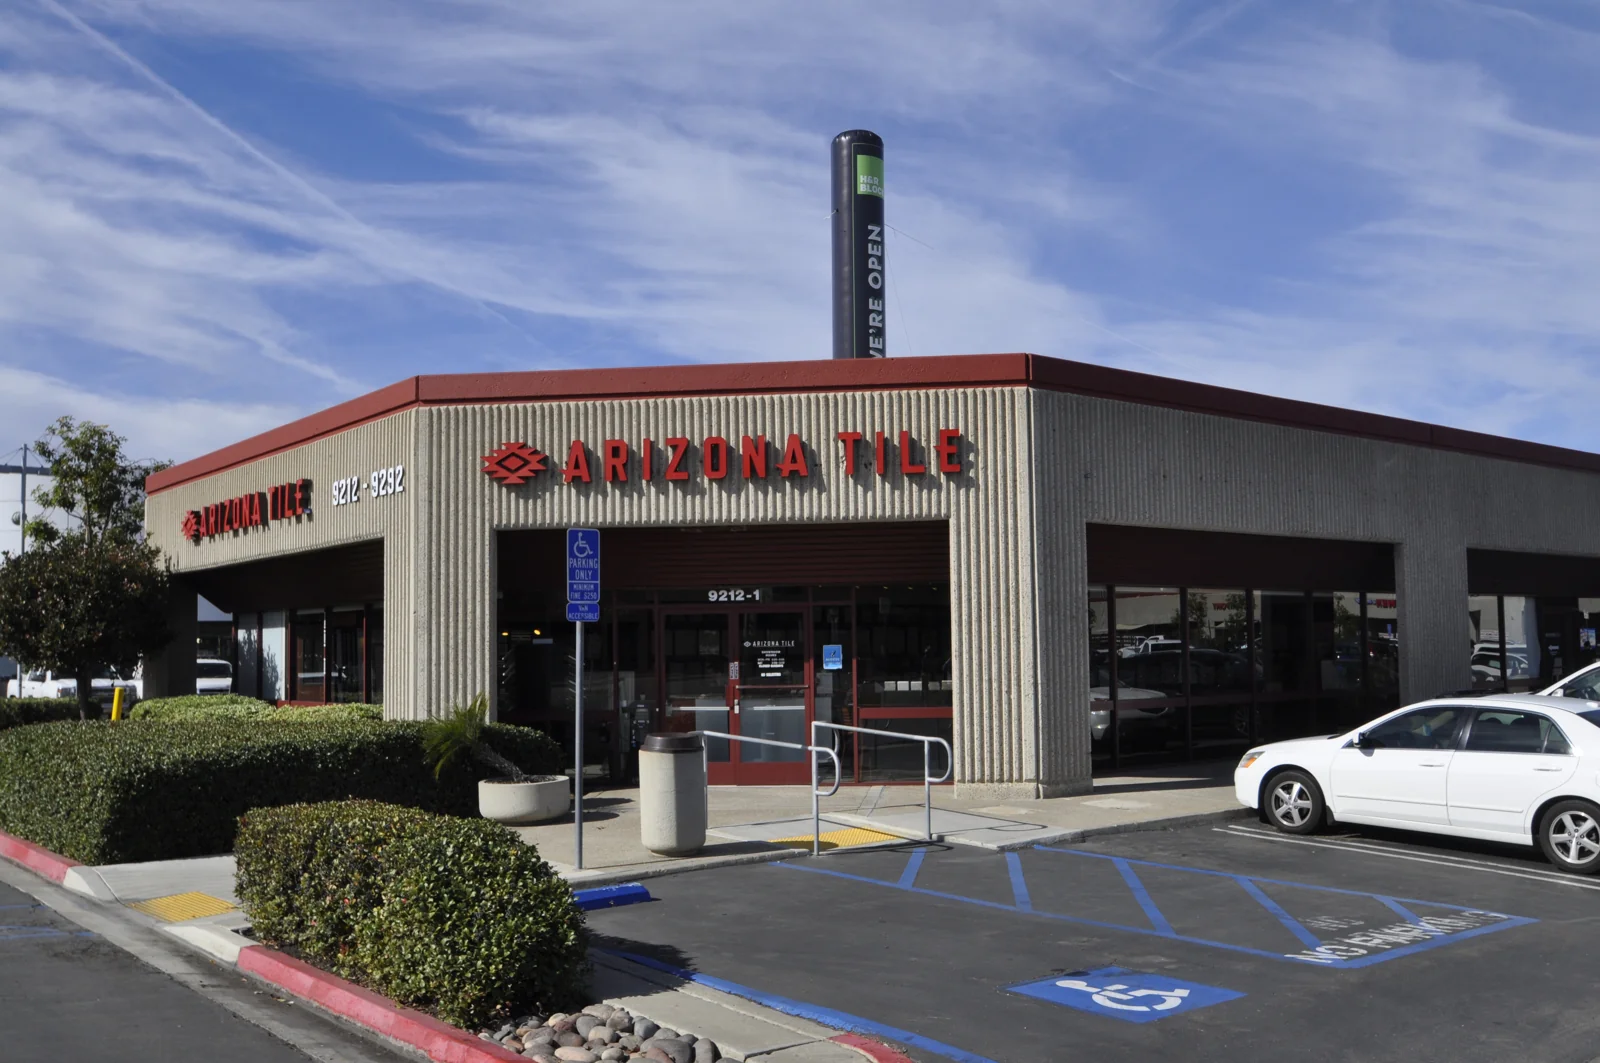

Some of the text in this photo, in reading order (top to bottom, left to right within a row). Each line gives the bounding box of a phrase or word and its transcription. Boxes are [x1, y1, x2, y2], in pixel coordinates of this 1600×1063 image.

[860, 175, 879, 185] H&R
[867, 224, 882, 290] OPEN
[559, 429, 961, 483] ARIZONA TILE
[332, 476, 358, 506] 9212
[371, 465, 404, 498] 9292
[200, 478, 304, 538] ARIZONA TILE
[569, 558, 598, 569] PARKING
[575, 570, 593, 580] ONLY
[708, 589, 760, 602] 9212-1
[568, 612, 598, 620] ACCESSIBLE
[752, 640, 795, 648] ARIZONA TILE
